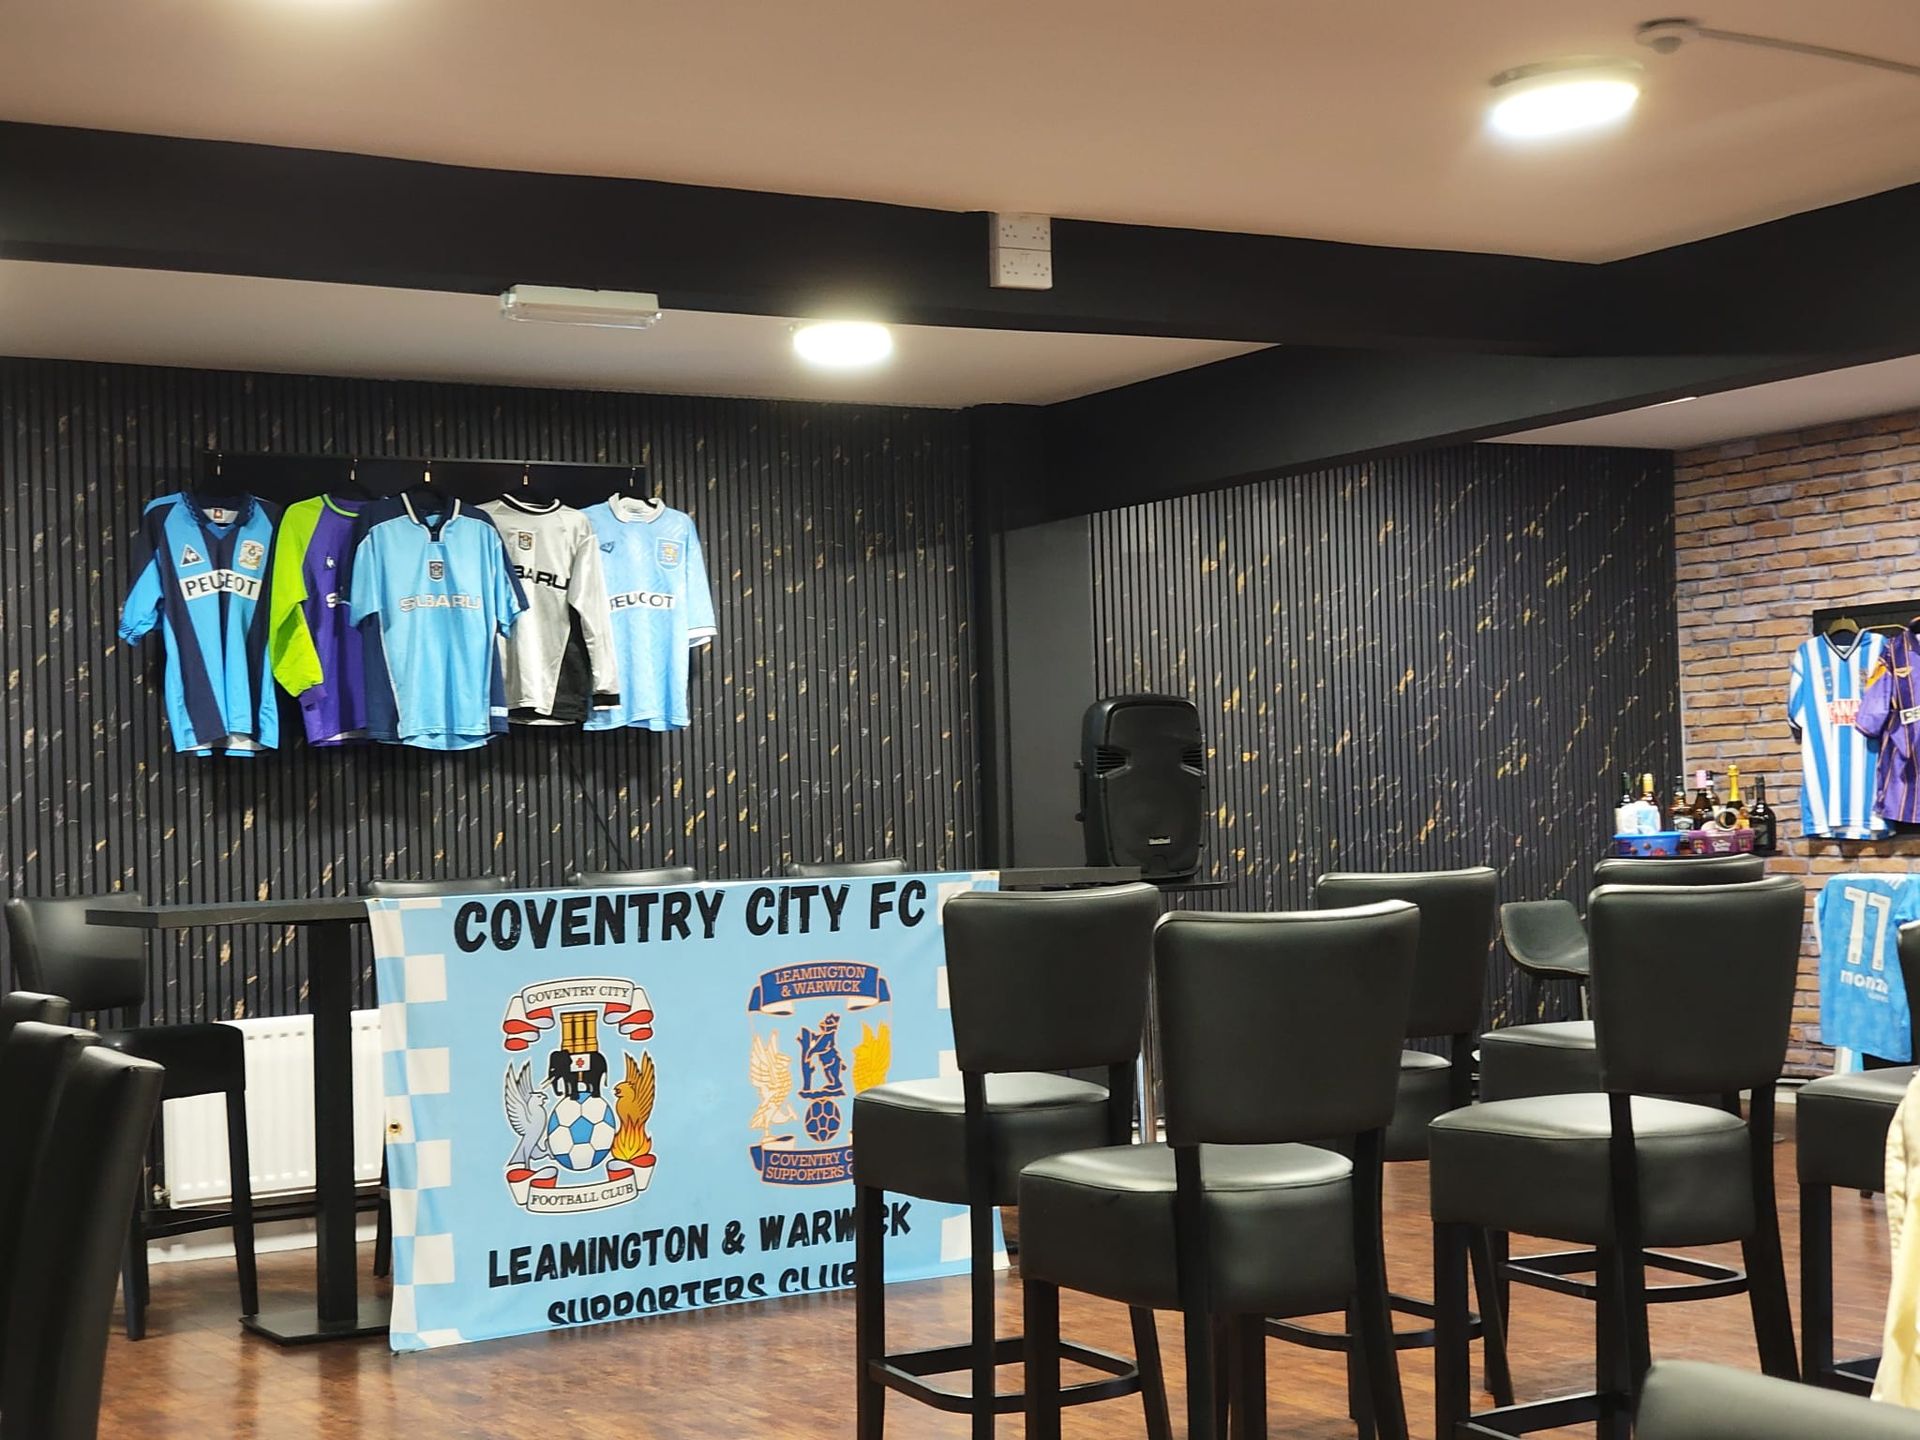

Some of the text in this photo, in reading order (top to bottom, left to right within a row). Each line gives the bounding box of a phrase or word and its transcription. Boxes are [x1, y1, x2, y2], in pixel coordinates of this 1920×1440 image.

[515, 565, 570, 591] BARU
[400, 594, 481, 612] SUBARU
[454, 880, 926, 953] COVENTRY CITY FC
[775, 966, 866, 984] LEAMINGTON
[527, 986, 629, 1004] COVENTRY CITY
[781, 980, 861, 997] & WARWICK
[770, 1152, 841, 1167] COVENTRY
[766, 1165, 845, 1181] SUPPORTERS
[530, 1183, 634, 1206] FOOTBALL CLUB
[489, 1201, 912, 1288] LEAMINGTON & WARWK
[547, 1272, 768, 1326] SUPPORTERS
